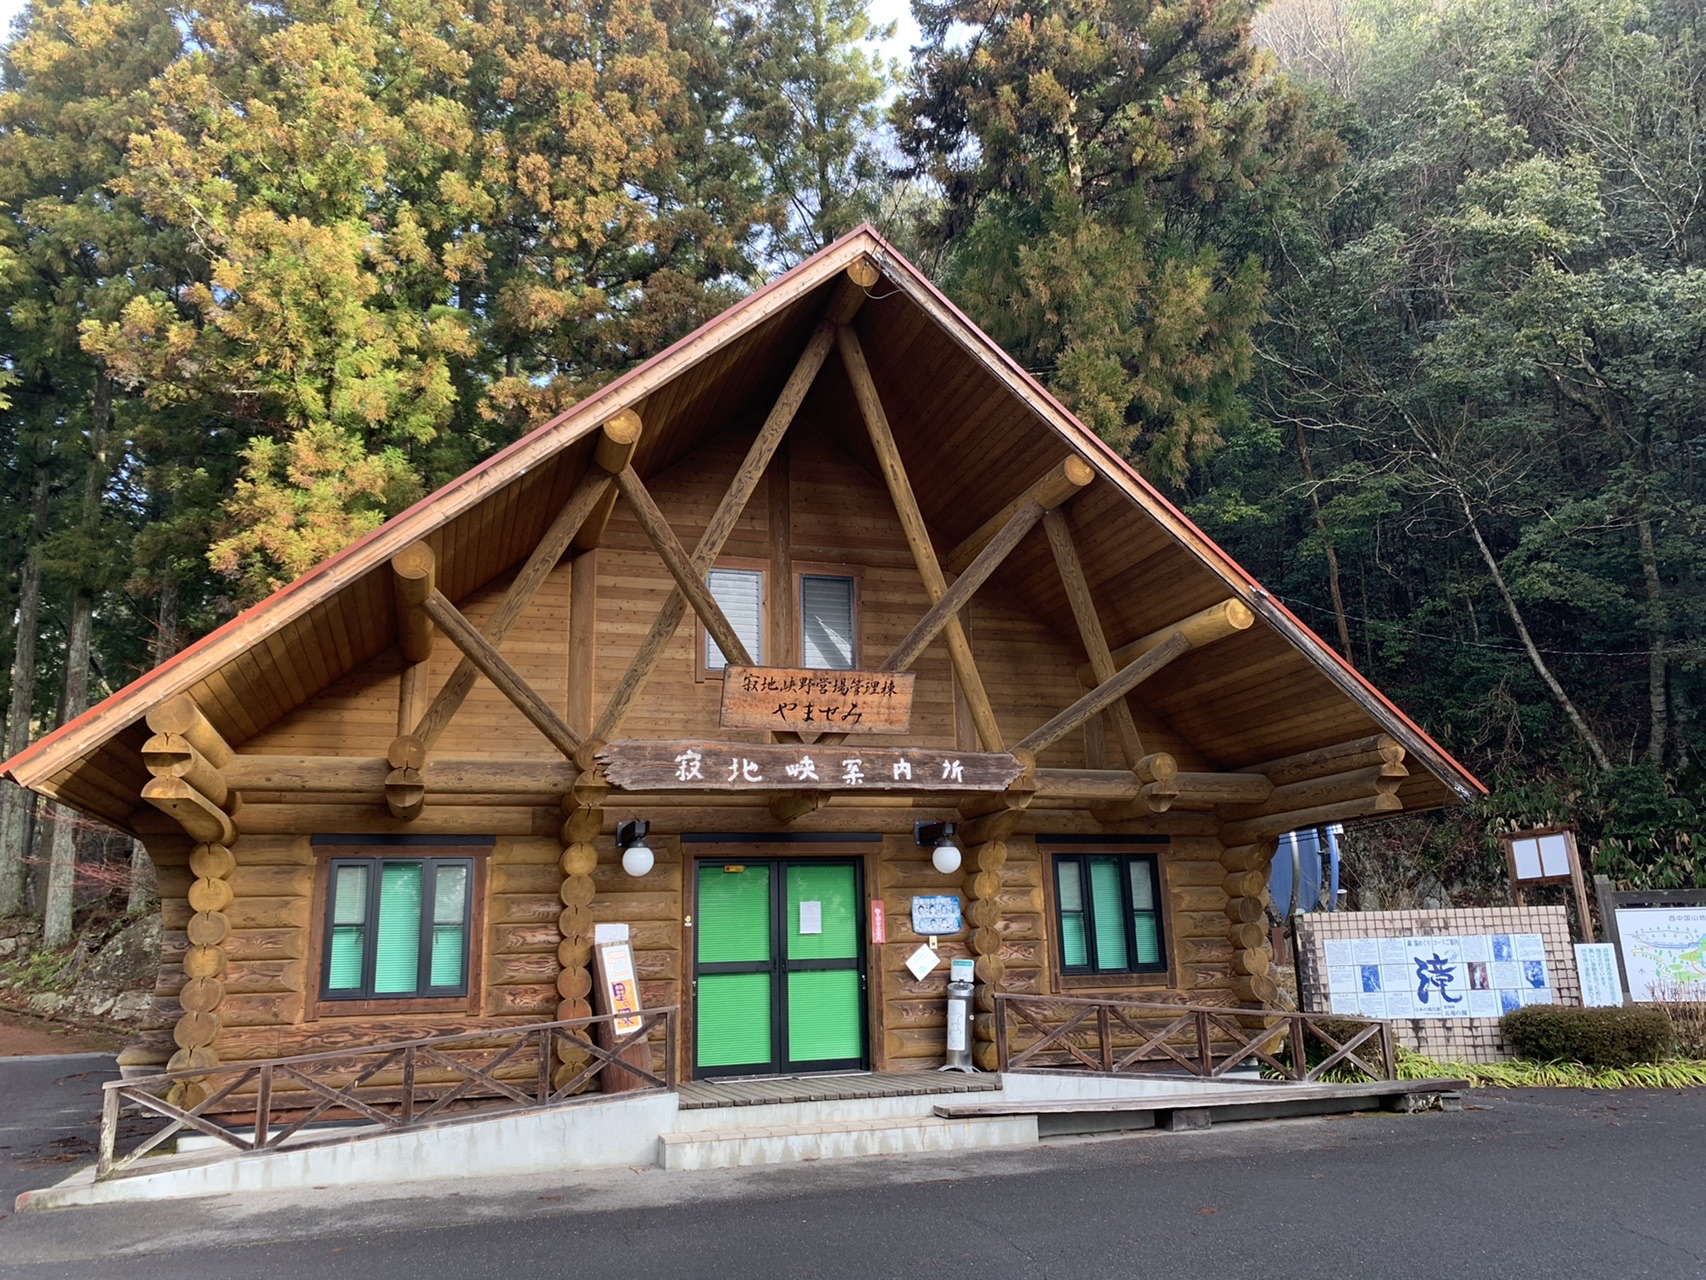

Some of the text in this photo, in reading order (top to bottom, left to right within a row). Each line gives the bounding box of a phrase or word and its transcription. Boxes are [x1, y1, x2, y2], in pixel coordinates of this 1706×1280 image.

[742, 673, 898, 697] 寂地峡野営場管理棟
[772, 702, 862, 724] やませみ
[674, 749, 964, 785] 寂地峡案内所
[1413, 952, 1463, 1004] 滝
